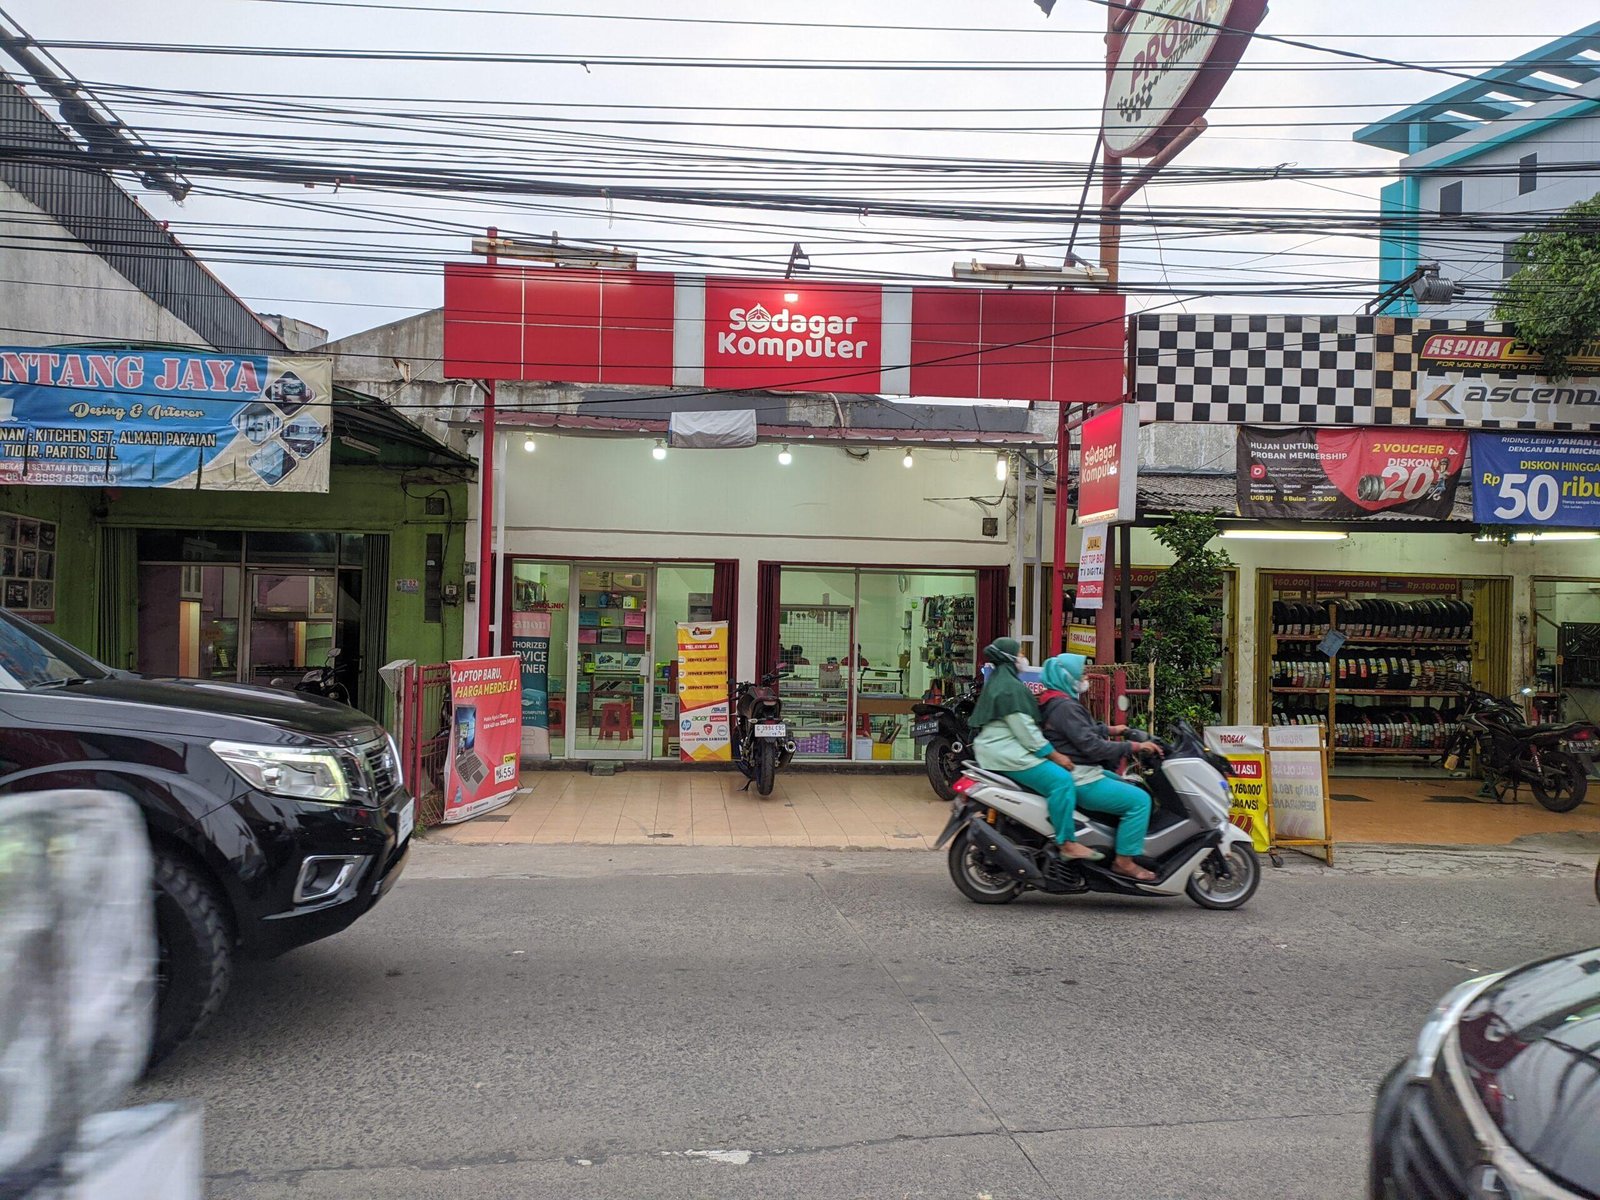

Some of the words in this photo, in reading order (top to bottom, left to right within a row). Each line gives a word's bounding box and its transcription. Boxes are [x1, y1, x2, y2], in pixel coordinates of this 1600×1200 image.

[729, 303, 858, 339] Sodagar
[718, 332, 868, 362] Komputer
[1428, 338, 1500, 357] ASPIRA
[1482, 362, 1519, 370] SAFETY
[155, 358, 261, 393] JAYA
[69, 402, 126, 420] Desing
[130, 403, 144, 418] &
[36, 429, 86, 444] KITCHEN
[119, 432, 163, 446] ALMARI
[166, 434, 216, 447] PAKAIAN
[1501, 436, 1530, 444] RIDING
[1557, 438, 1592, 446] TAHAN
[1250, 441, 1280, 450] HUJAN
[1282, 442, 1319, 450] UNTUNG
[1372, 443, 1381, 453] 2
[1383, 444, 1445, 454] VOUCHER
[96, 447, 117, 460] DLL
[1085, 443, 1117, 466] Sodagar
[1250, 450, 1286, 459] PROBAN
[1289, 452, 1348, 460] MEMBERSHIP
[32, 464, 66, 472] SELATAN
[1388, 458, 1433, 467] DISKON
[1520, 460, 1559, 470] DISKON
[1561, 462, 1600, 472] HINGGA
[1081, 460, 1119, 483] Komputer
[1483, 473, 1500, 486] Rp
[1493, 473, 1559, 521] 50
[1338, 580, 1378, 588] PROBAN
[512, 619, 547, 630] anon
[1072, 631, 1096, 643] SWALLOW
[452, 669, 483, 683] LAPTOP
[455, 684, 483, 698] HARGA
[1220, 735, 1247, 744] PROBAN
[1241, 765, 1257, 775] ASLI
